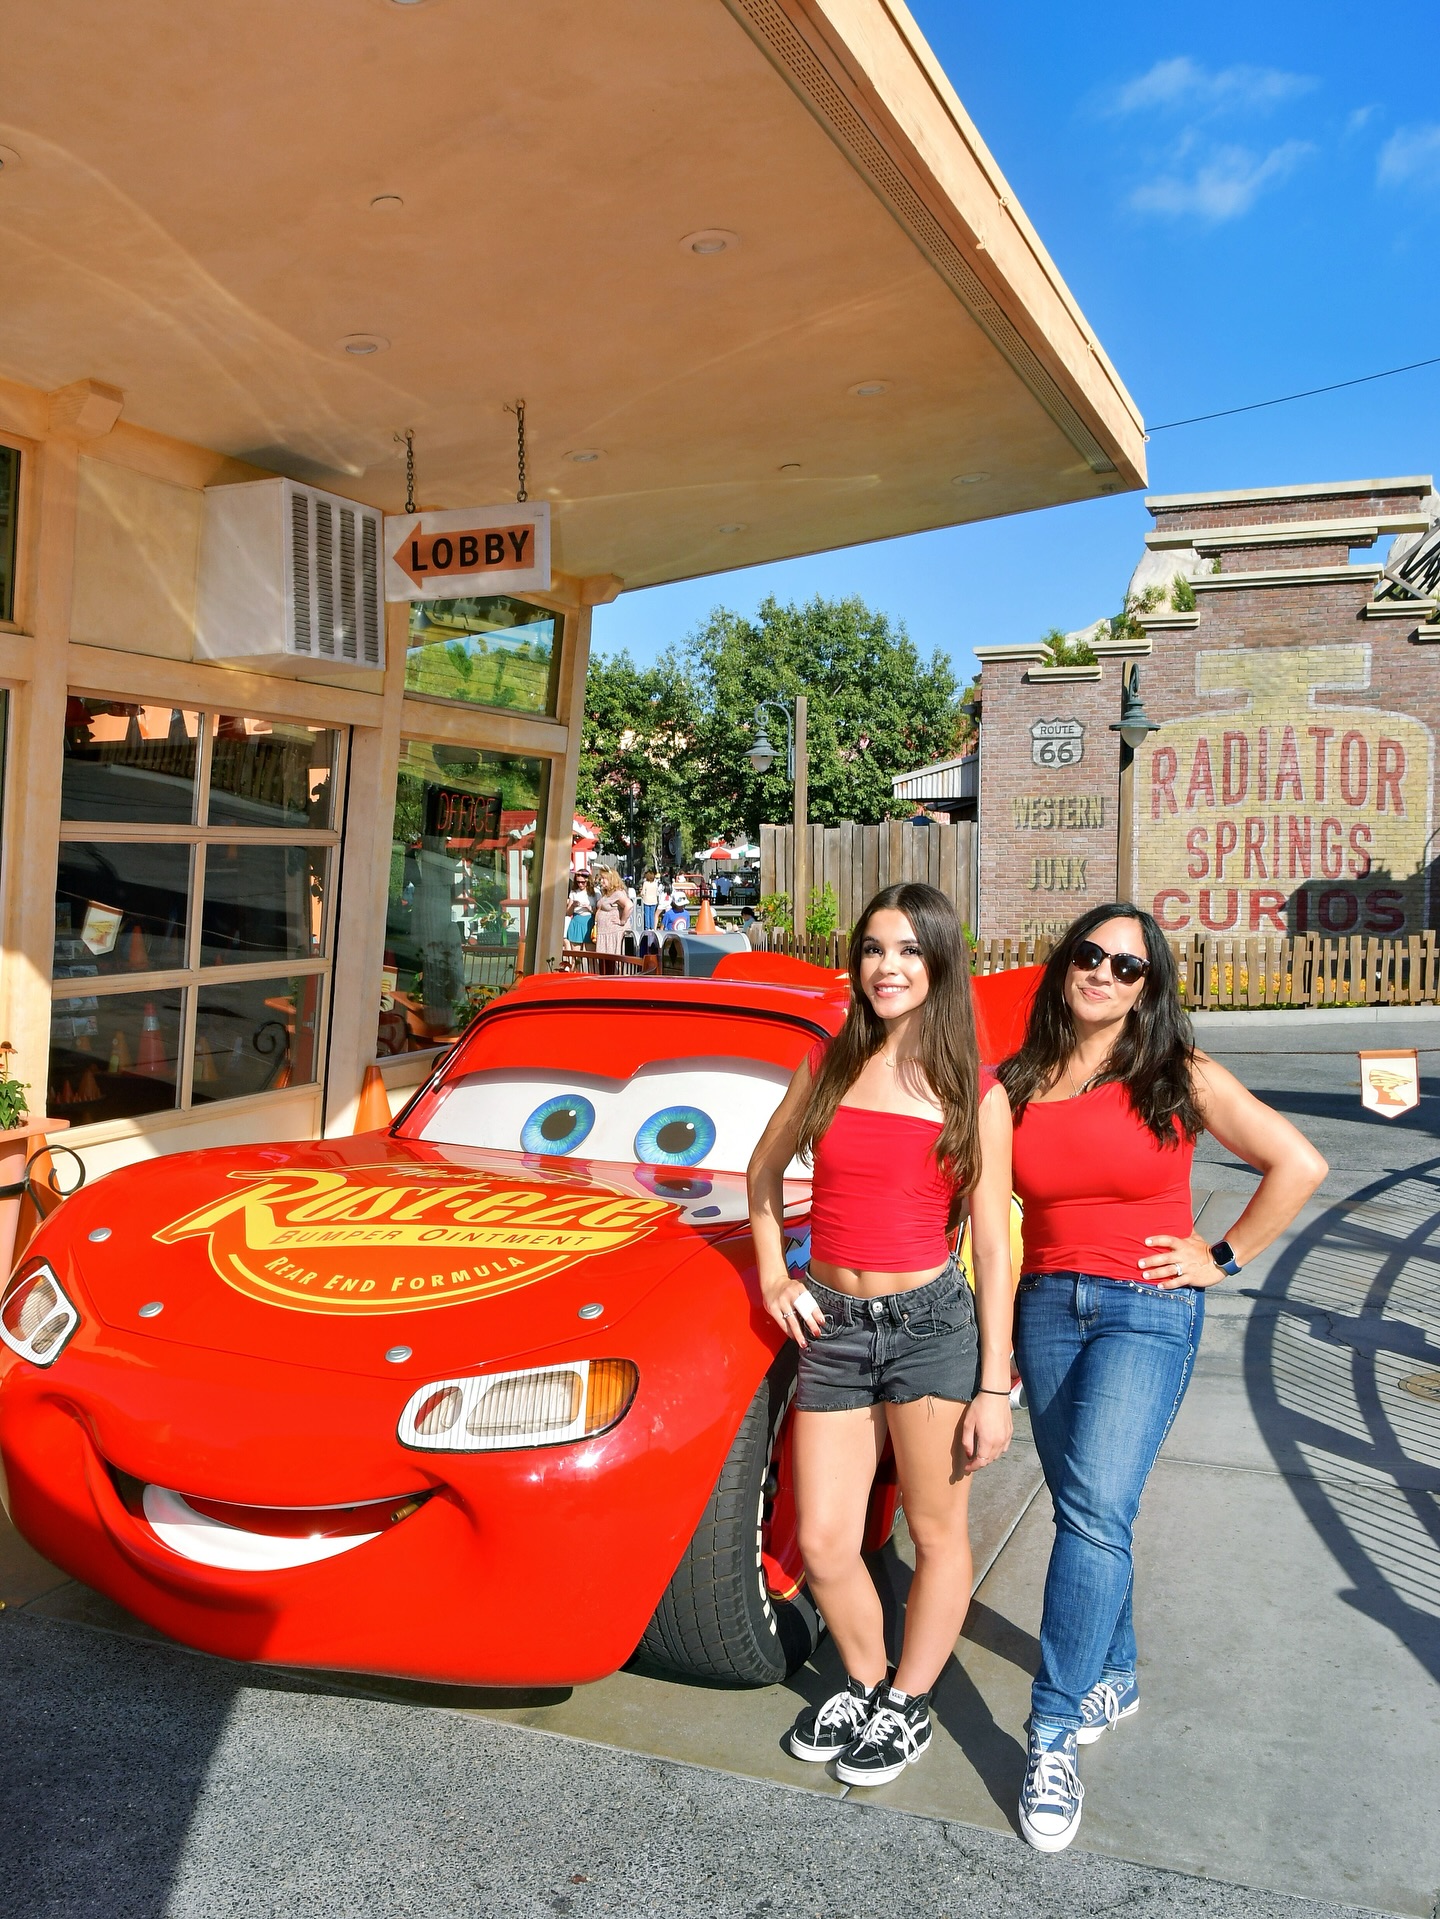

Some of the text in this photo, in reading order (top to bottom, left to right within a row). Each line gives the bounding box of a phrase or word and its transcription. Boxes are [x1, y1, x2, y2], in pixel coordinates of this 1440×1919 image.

[412, 530, 529, 571] LOBBY
[1040, 725, 1075, 735] ROUTE
[1039, 741, 1074, 763] 66
[1151, 725, 1408, 820] RADIATOR
[1011, 795, 1104, 829] WESTERN
[1186, 815, 1373, 880] SPRINGS
[1027, 857, 1087, 891] JUNK
[1151, 888, 1406, 932] CURIOS
[269, 1228, 592, 1246] BUMPER OINTMENT
[264, 1256, 526, 1292] REAR END FORMULA
